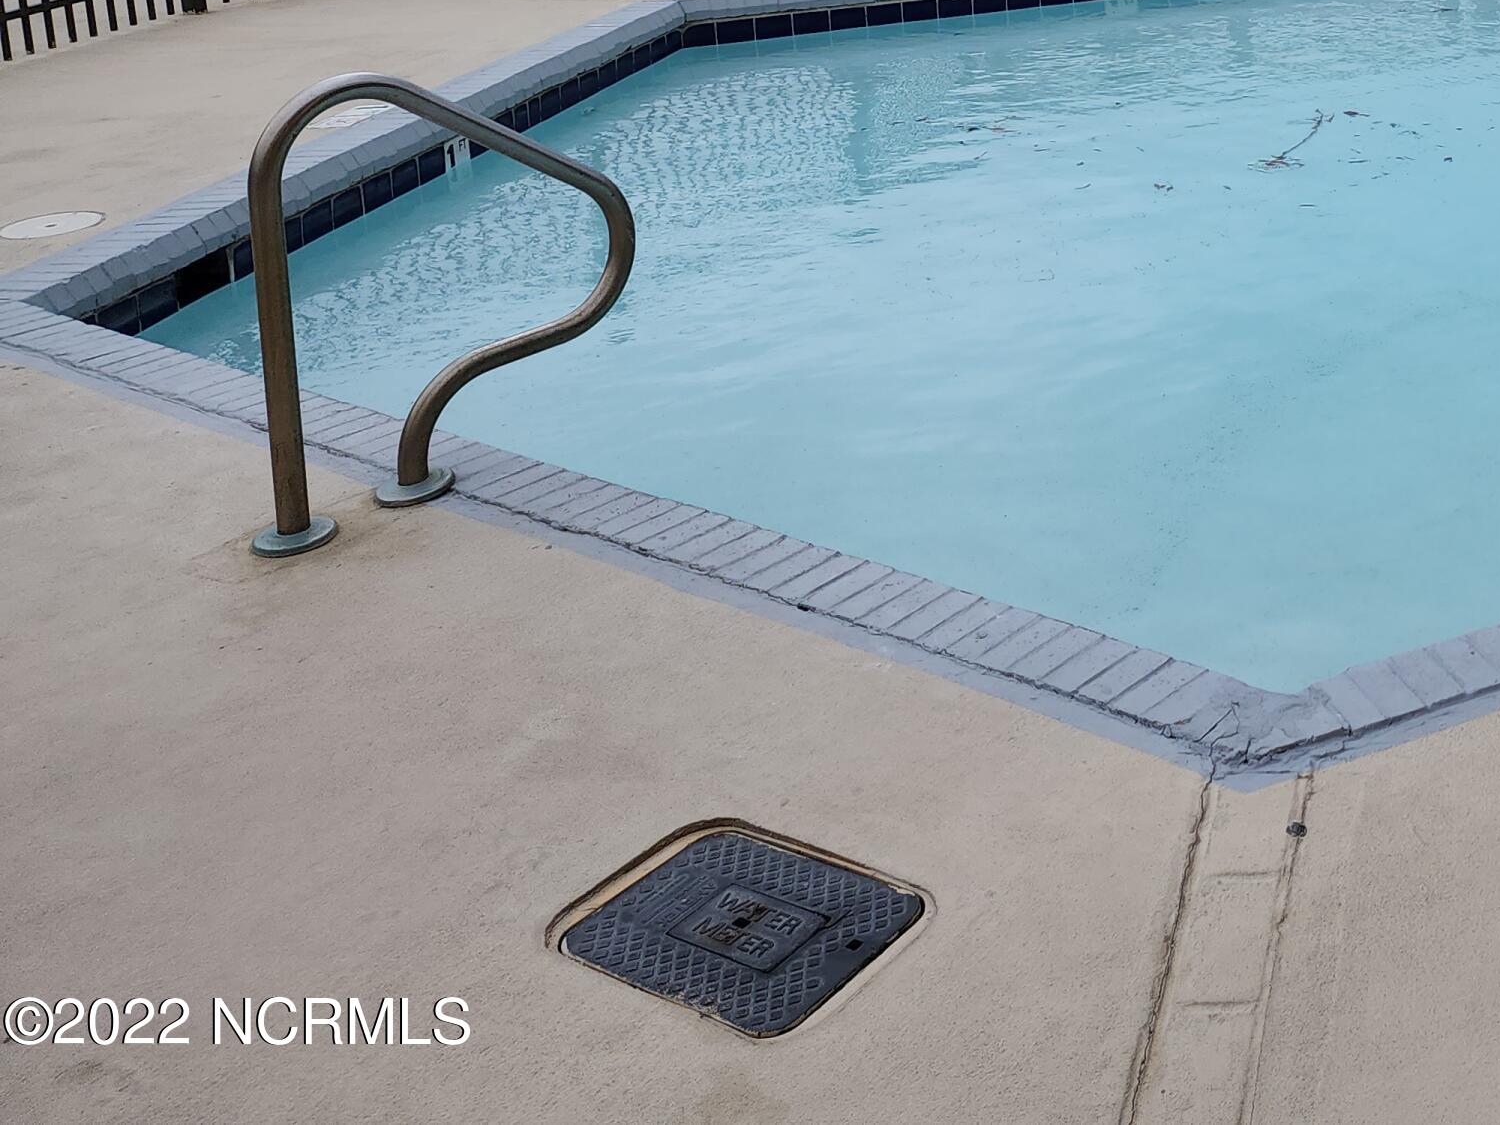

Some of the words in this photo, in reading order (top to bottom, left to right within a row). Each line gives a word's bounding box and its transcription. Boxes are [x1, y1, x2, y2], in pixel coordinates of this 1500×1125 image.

[446, 143, 456, 168] 1
[458, 138, 467, 152] FT
[717, 892, 803, 936] WATER
[691, 916, 775, 959] METER
